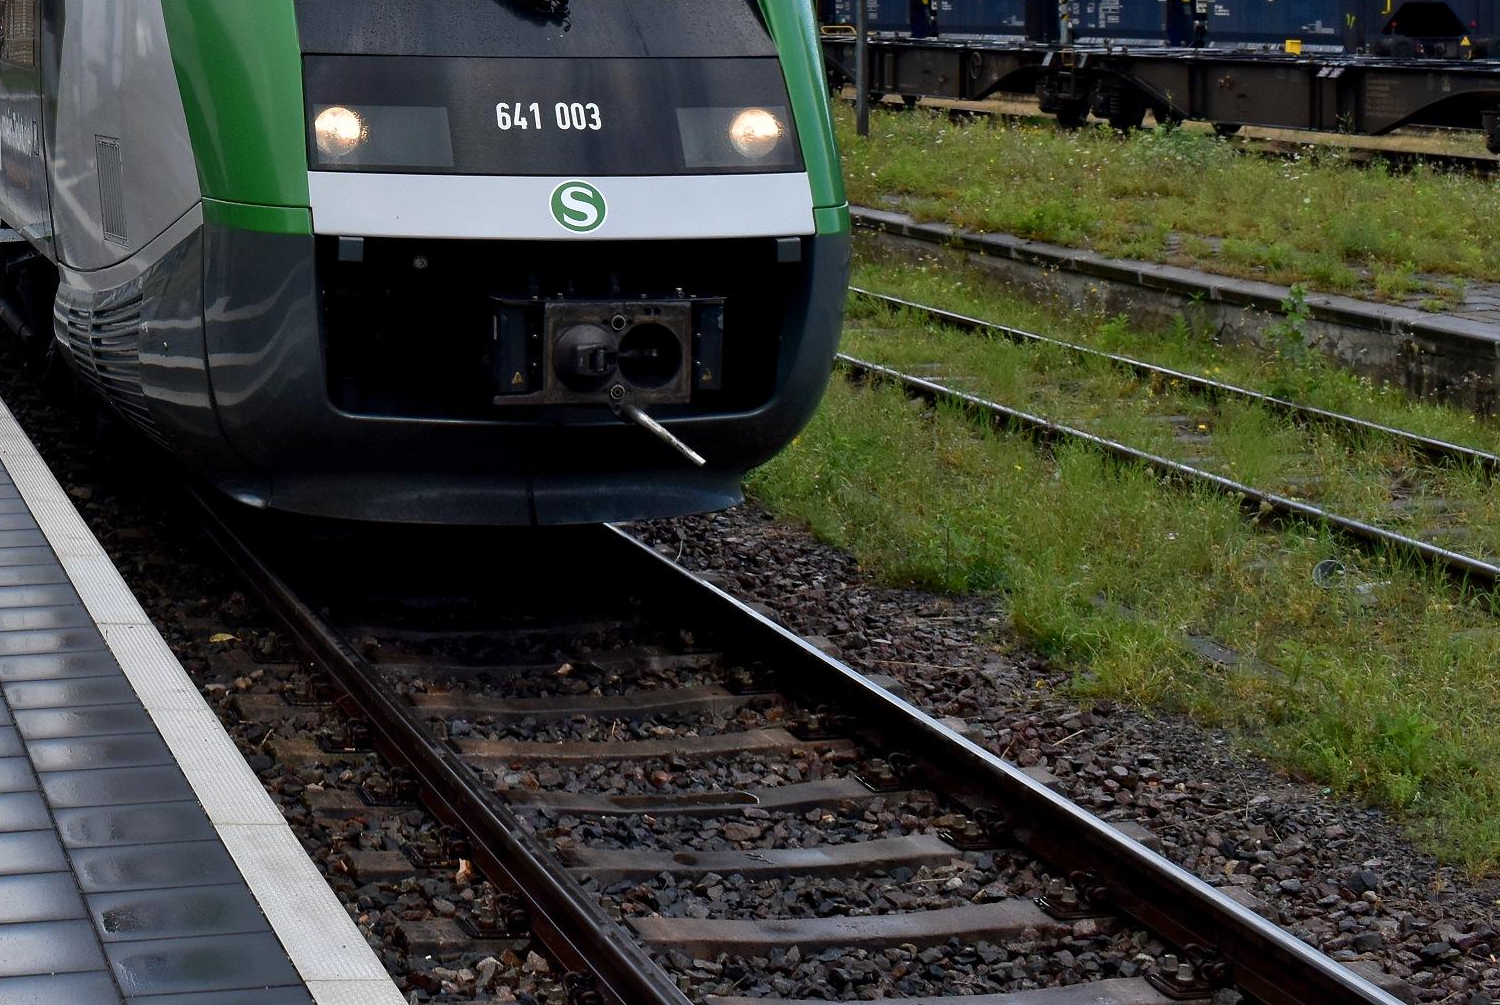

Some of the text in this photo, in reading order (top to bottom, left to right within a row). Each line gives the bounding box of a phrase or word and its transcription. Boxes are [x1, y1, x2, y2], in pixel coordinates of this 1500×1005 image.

[495, 102, 602, 130] 641 003
[560, 186, 599, 227] S
